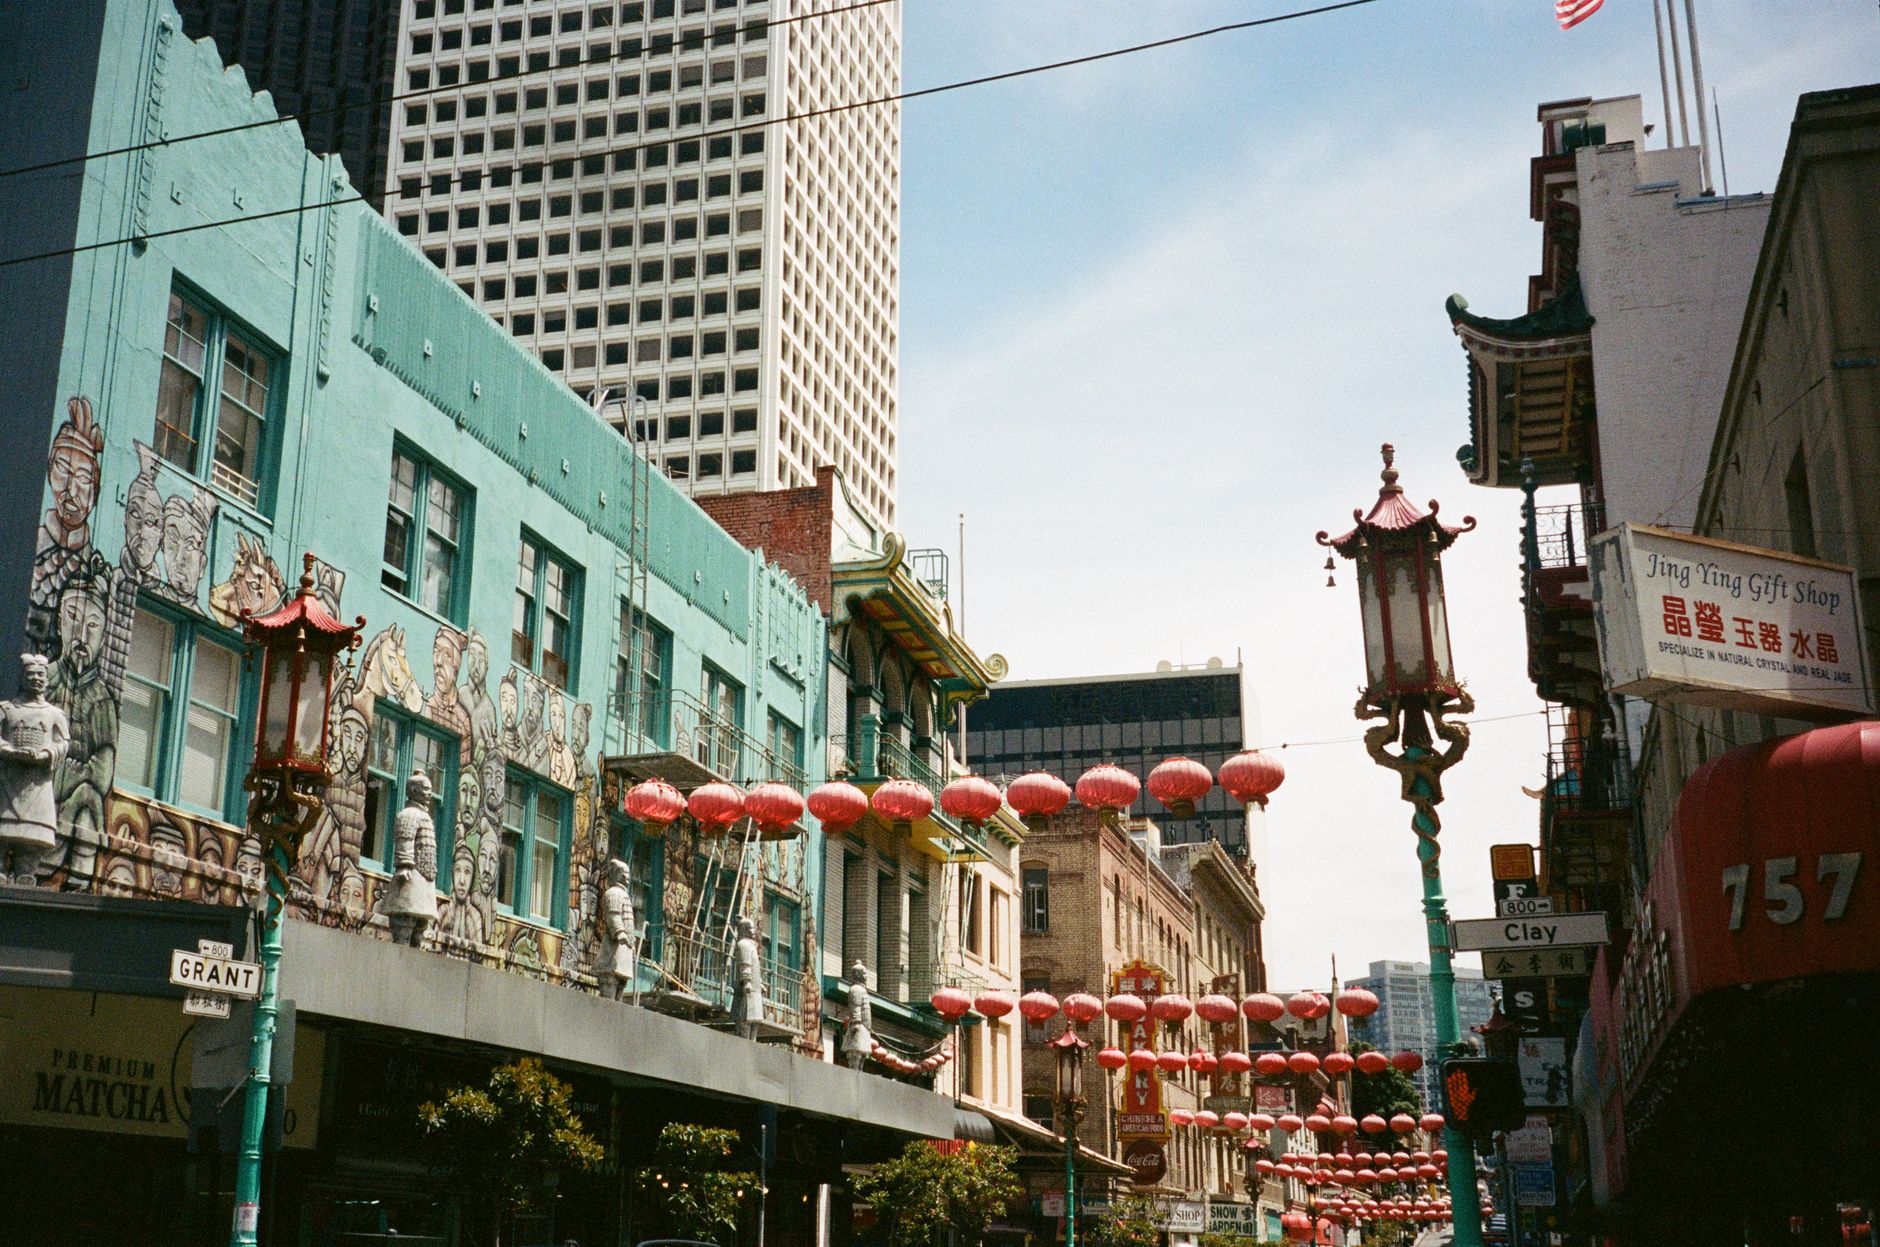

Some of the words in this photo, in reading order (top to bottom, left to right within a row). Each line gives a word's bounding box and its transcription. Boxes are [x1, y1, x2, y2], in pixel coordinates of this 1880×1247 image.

[1647, 553, 1690, 588] Jing
[1696, 562, 1742, 598] Ying
[1748, 572, 1788, 604] Gift
[1794, 580, 1840, 615] Shop
[1658, 641, 1705, 660] SPECIALIZE
[1707, 650, 1716, 661] IN
[1718, 652, 1754, 668] NATURAL
[1756, 659, 1790, 674] CRYSTAL
[1793, 665, 1808, 676] AND
[1810, 667, 1831, 681] REAL
[1833, 672, 1853, 685] JADE
[1722, 850, 1863, 931] 757
[1507, 900, 1537, 914] 800
[1504, 923, 1558, 944] Clay
[211, 944, 228, 957] 800
[180, 958, 254, 989] GRANT
[53, 1048, 155, 1080] PREMIUM
[32, 1070, 170, 1124] MATCHA
[1121, 1114, 1156, 1123] CHINESE
[1176, 1210, 1200, 1221] SHOP
[1210, 1206, 1238, 1219] SNOW
